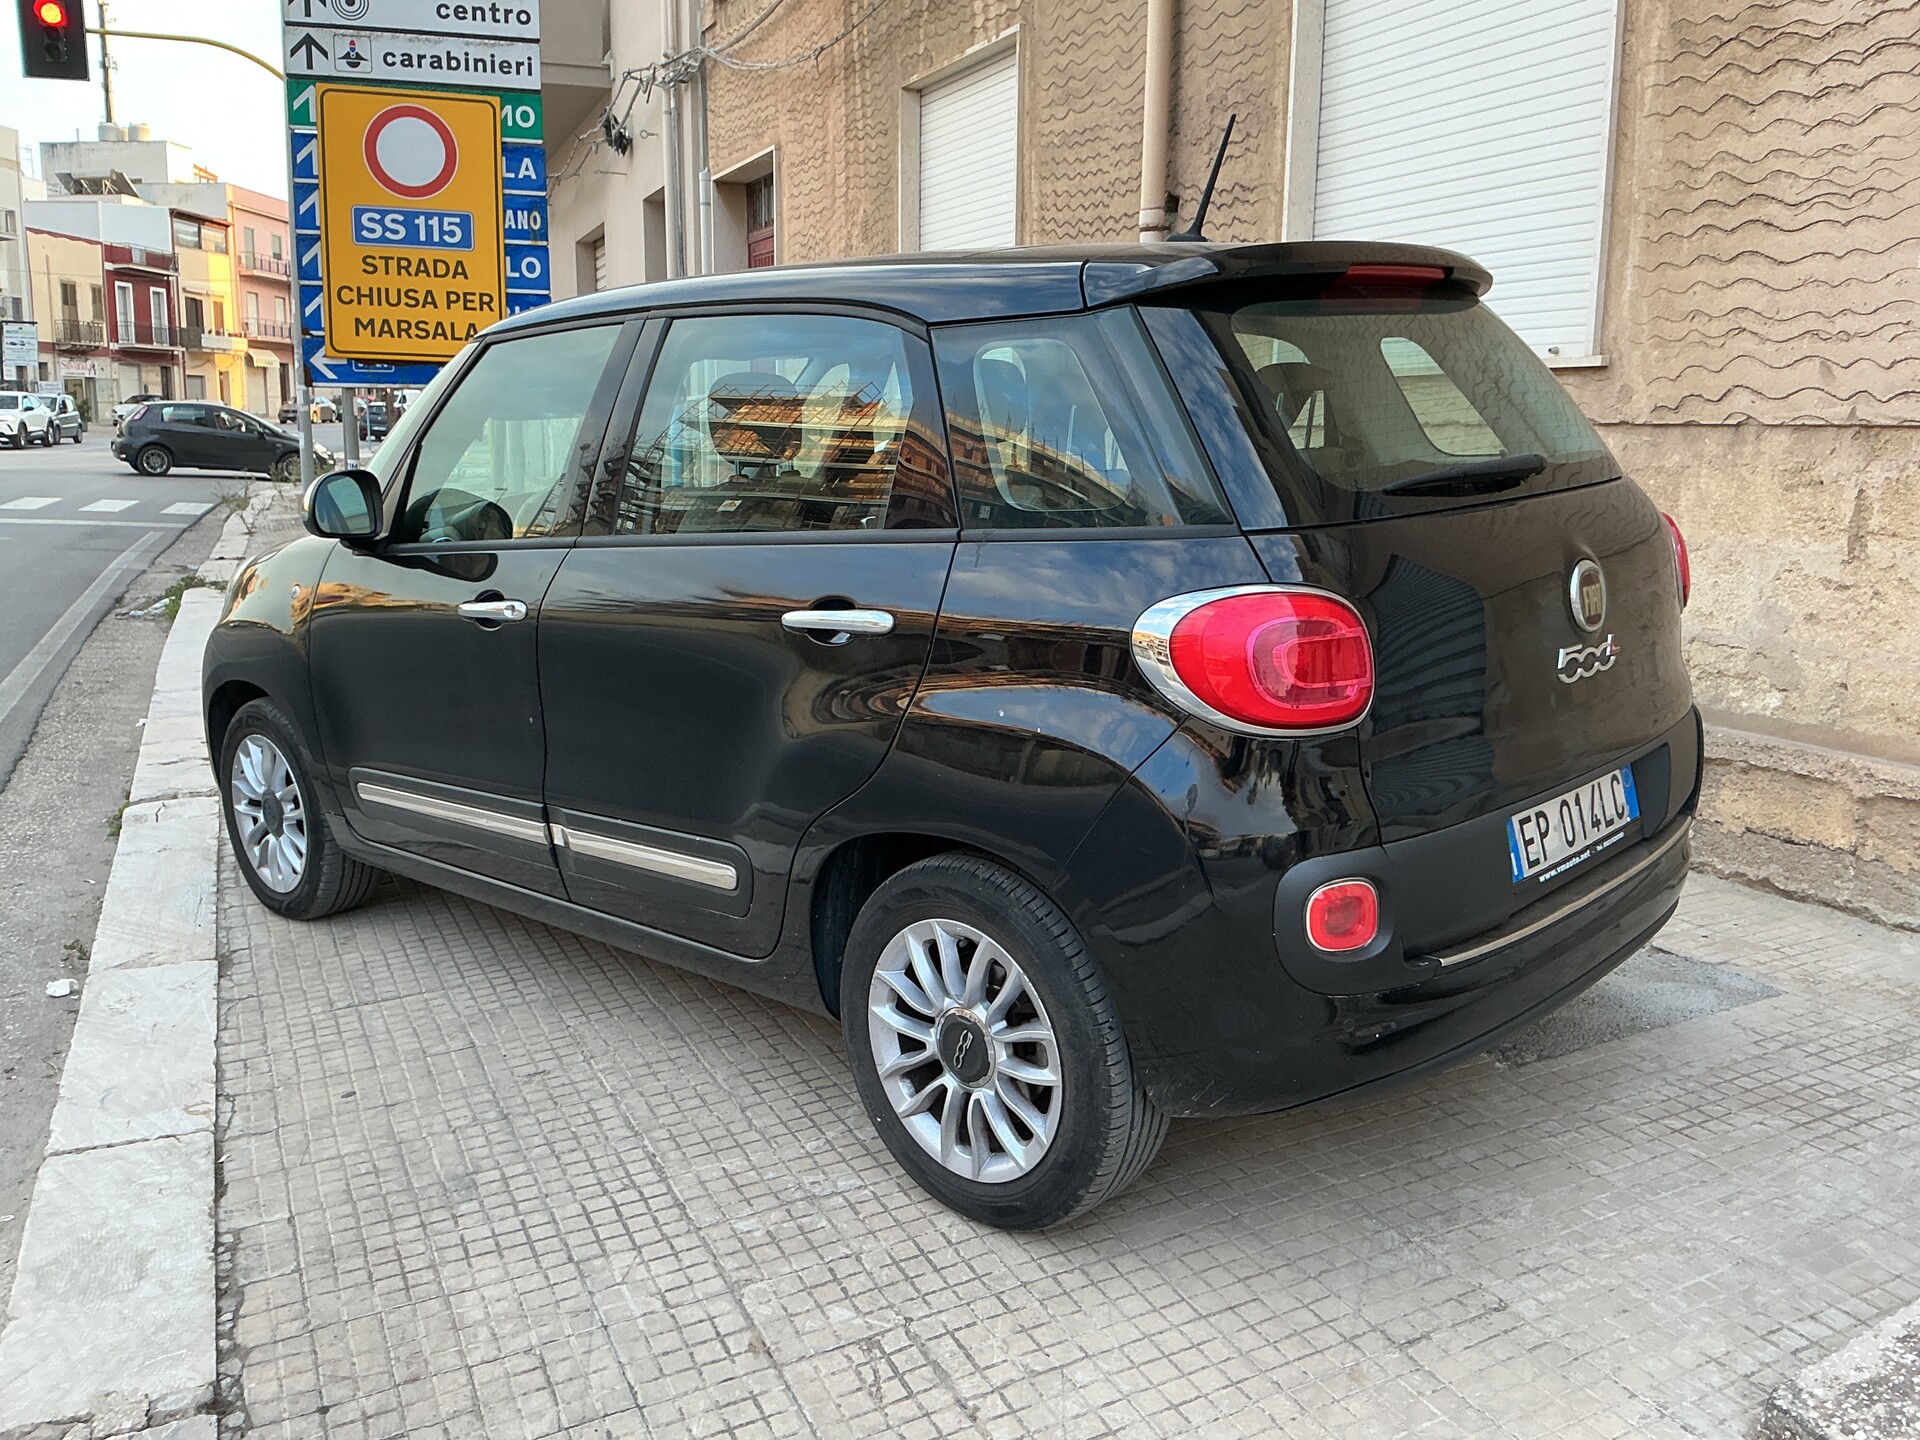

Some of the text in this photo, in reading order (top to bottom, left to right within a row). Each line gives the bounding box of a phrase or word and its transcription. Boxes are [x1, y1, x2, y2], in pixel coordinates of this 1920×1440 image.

[436, 2, 532, 26] centro
[382, 50, 533, 77] carabinieri
[360, 212, 462, 244] SS 115
[504, 209, 541, 230] ANO
[361, 254, 469, 280] STRADA
[505, 256, 541, 279] LO
[336, 285, 438, 309] CHIUSA
[446, 291, 495, 312] PER
[354, 317, 479, 341] MARSALA
[1518, 773, 1625, 870] EP 014LC
